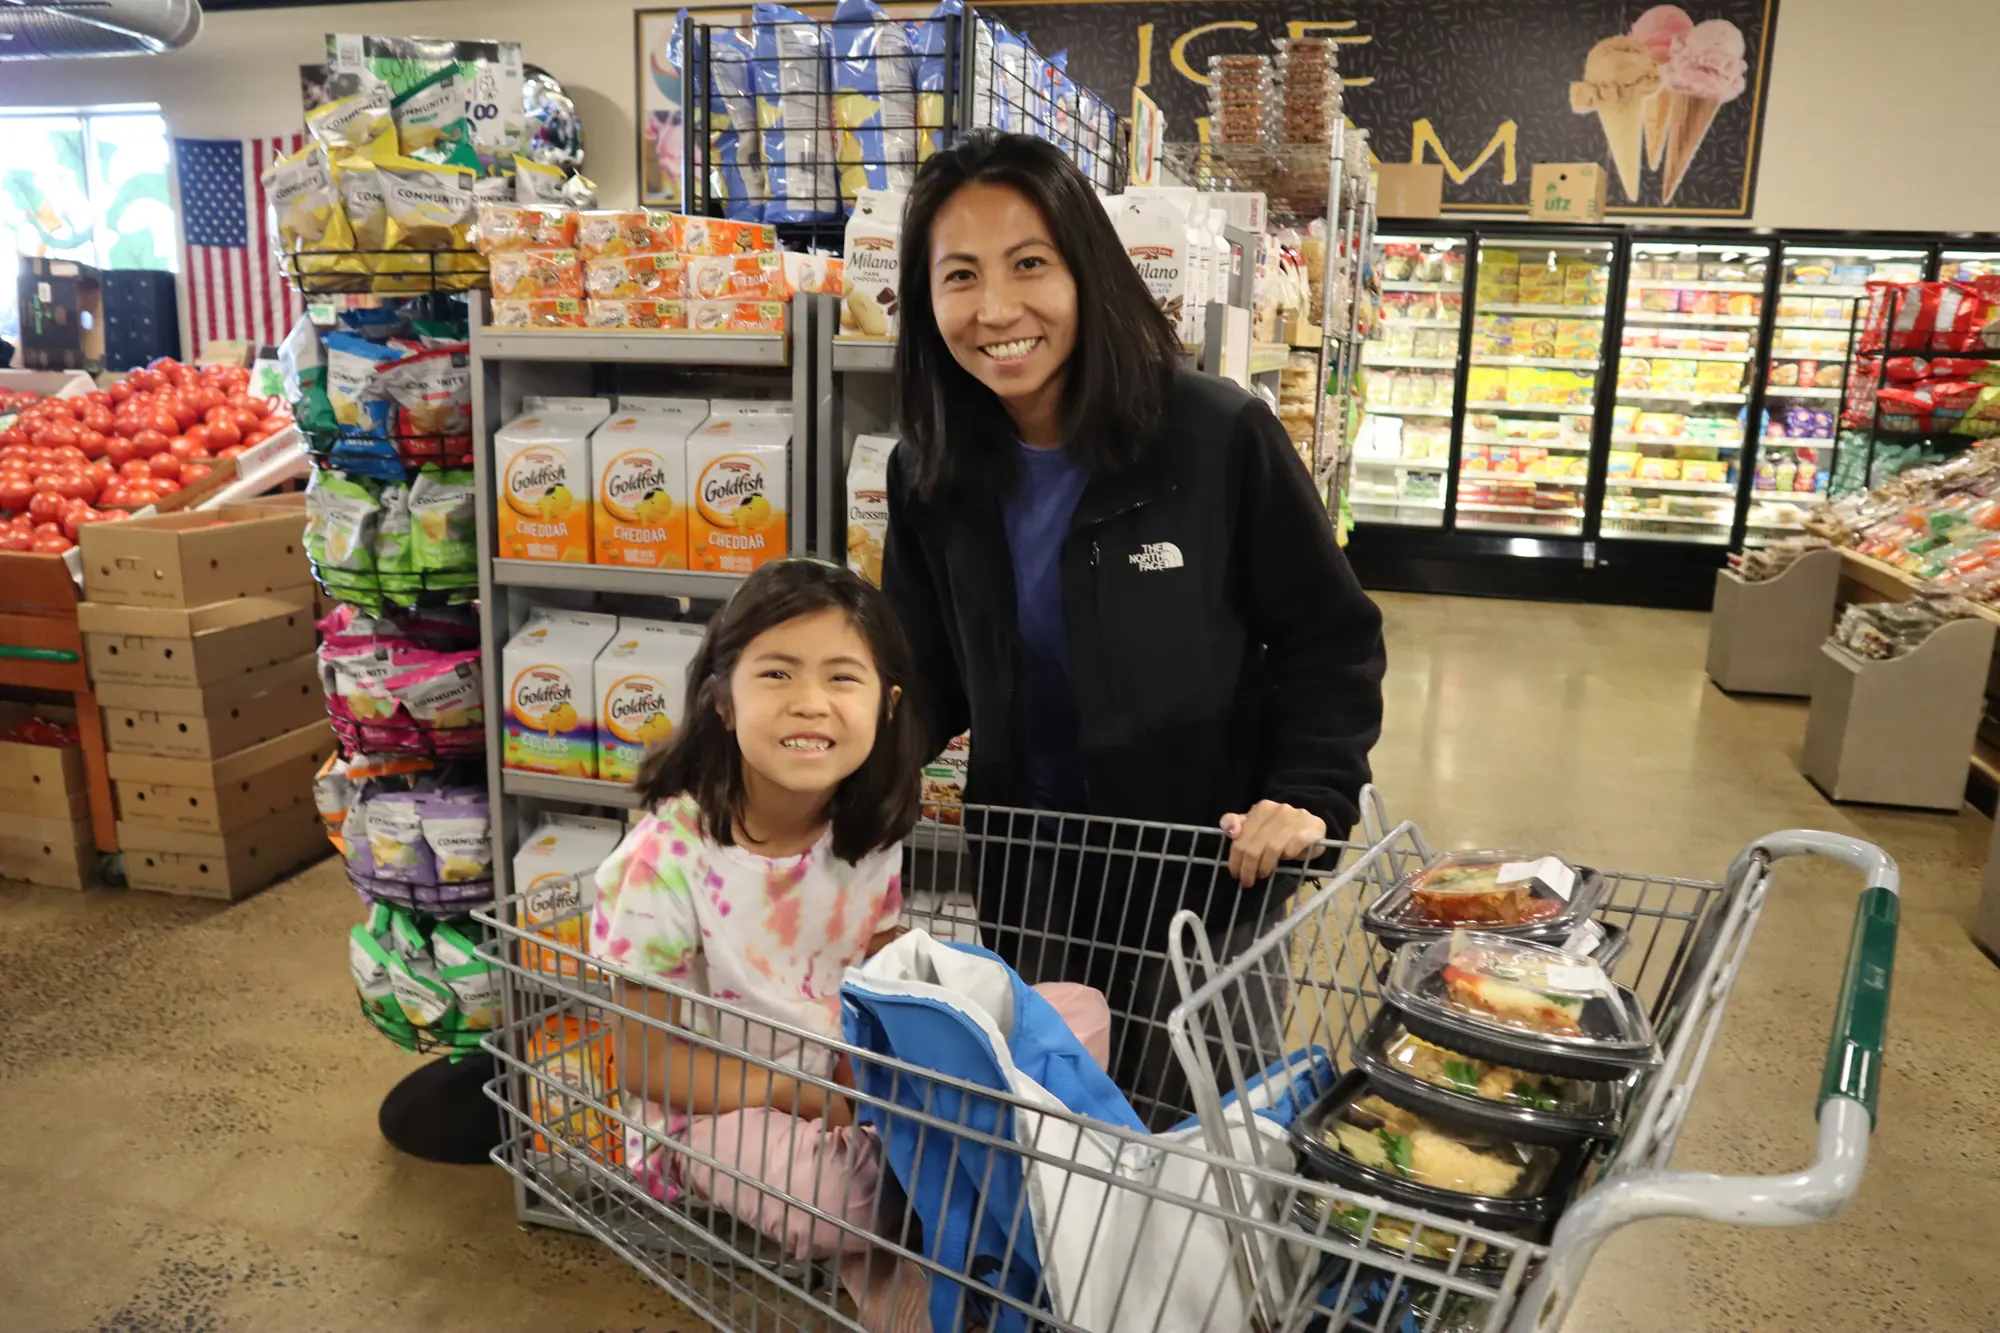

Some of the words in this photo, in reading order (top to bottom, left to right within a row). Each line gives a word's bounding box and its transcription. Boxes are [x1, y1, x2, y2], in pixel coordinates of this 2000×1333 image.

[399, 95, 451, 118] OMMUNITY
[397, 188, 467, 207] COMMUNITY
[1545, 196, 1571, 211] utz
[846, 251, 899, 271] Milano
[511, 463, 567, 493] Goldfish
[609, 467, 665, 498] Goldfish
[705, 471, 764, 503] Goldfish
[850, 506, 889, 520] Chessm
[515, 521, 569, 538] CHEDDAR
[613, 525, 668, 543] CHEDDAR
[708, 531, 766, 550] CHEDDAR
[1141, 543, 1163, 553] THE
[1128, 552, 1163, 564] NORTH
[1139, 560, 1165, 572] FACE
[413, 683, 472, 708] COMMUNITY
[517, 683, 572, 707] Goldfish
[611, 694, 667, 719] Goldfish
